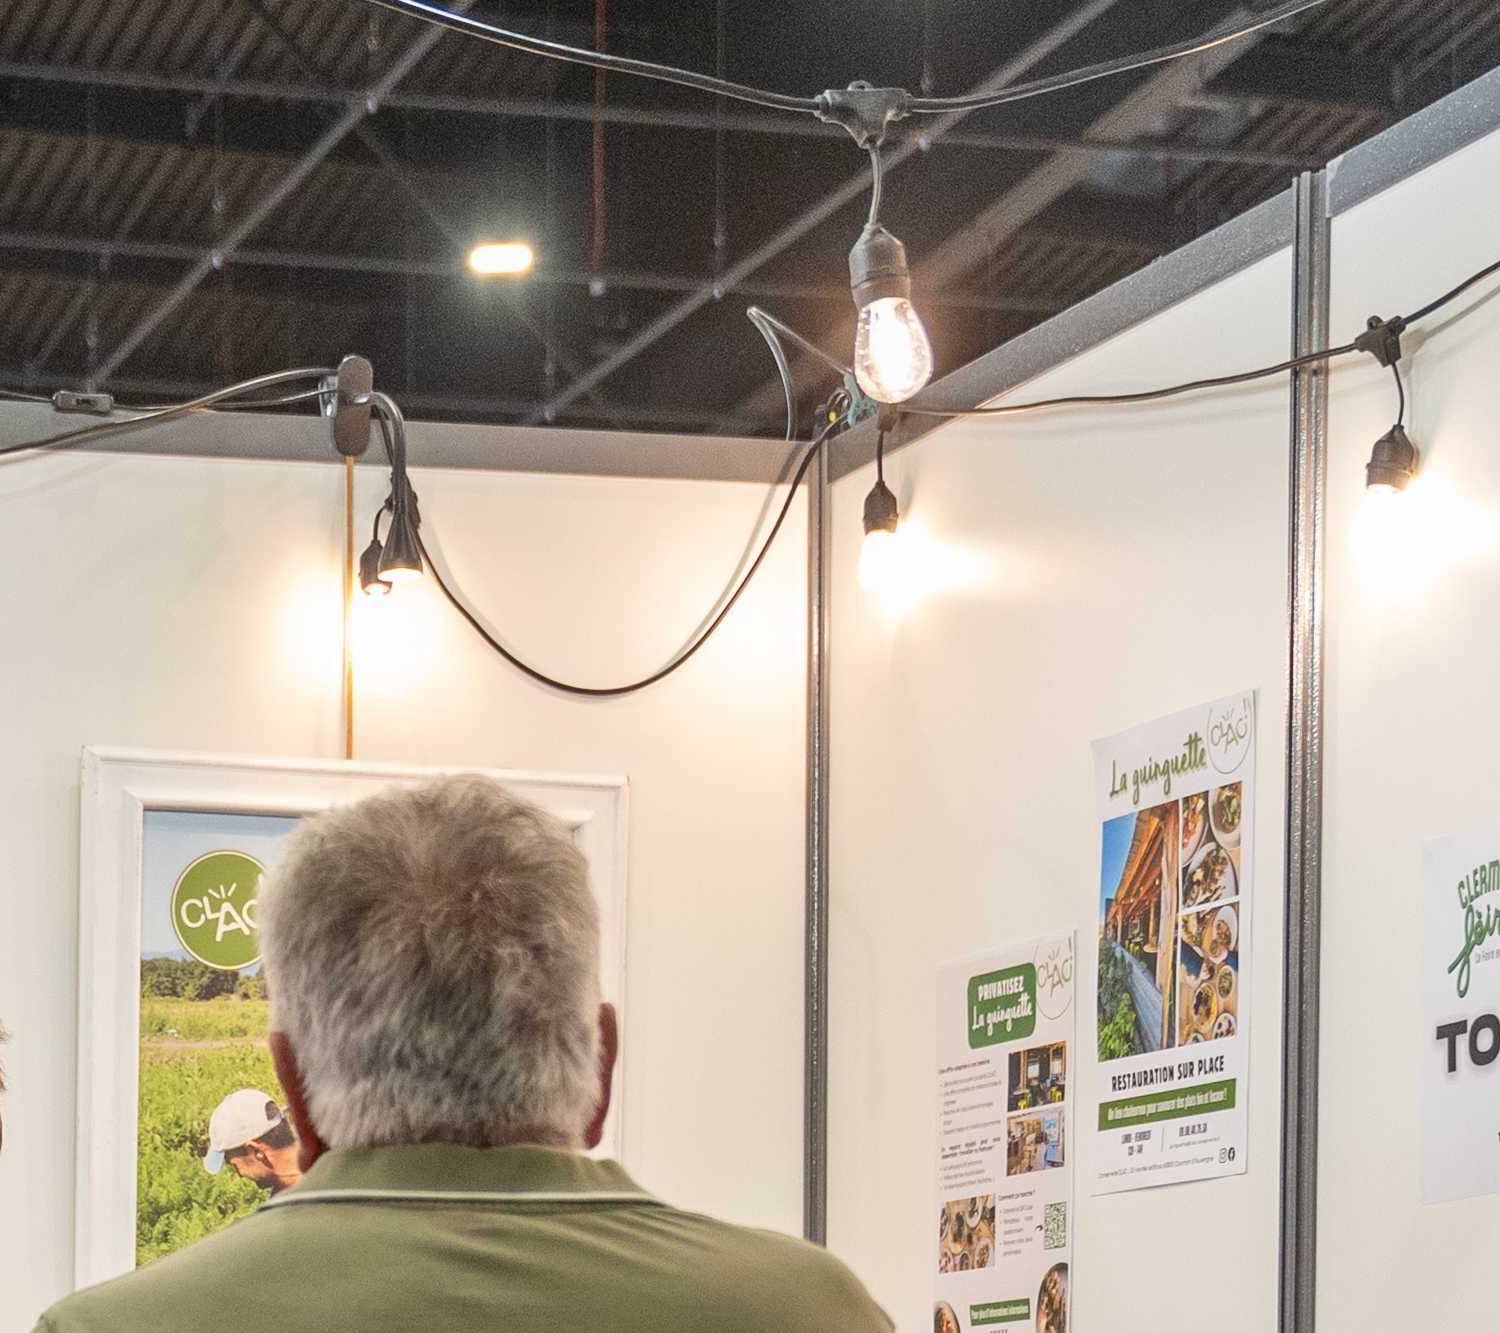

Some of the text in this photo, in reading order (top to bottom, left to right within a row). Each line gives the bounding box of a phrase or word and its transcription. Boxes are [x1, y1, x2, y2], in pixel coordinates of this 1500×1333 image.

[1110, 697, 1250, 805] La guinguette CLAC!
[1036, 936, 1073, 997] CLAC!
[977, 975, 1025, 1002] PRIVATISEZ
[972, 995, 1033, 1038] La guinguette
[1112, 1055, 1224, 1092] RESTAURATION SUR PLACE
